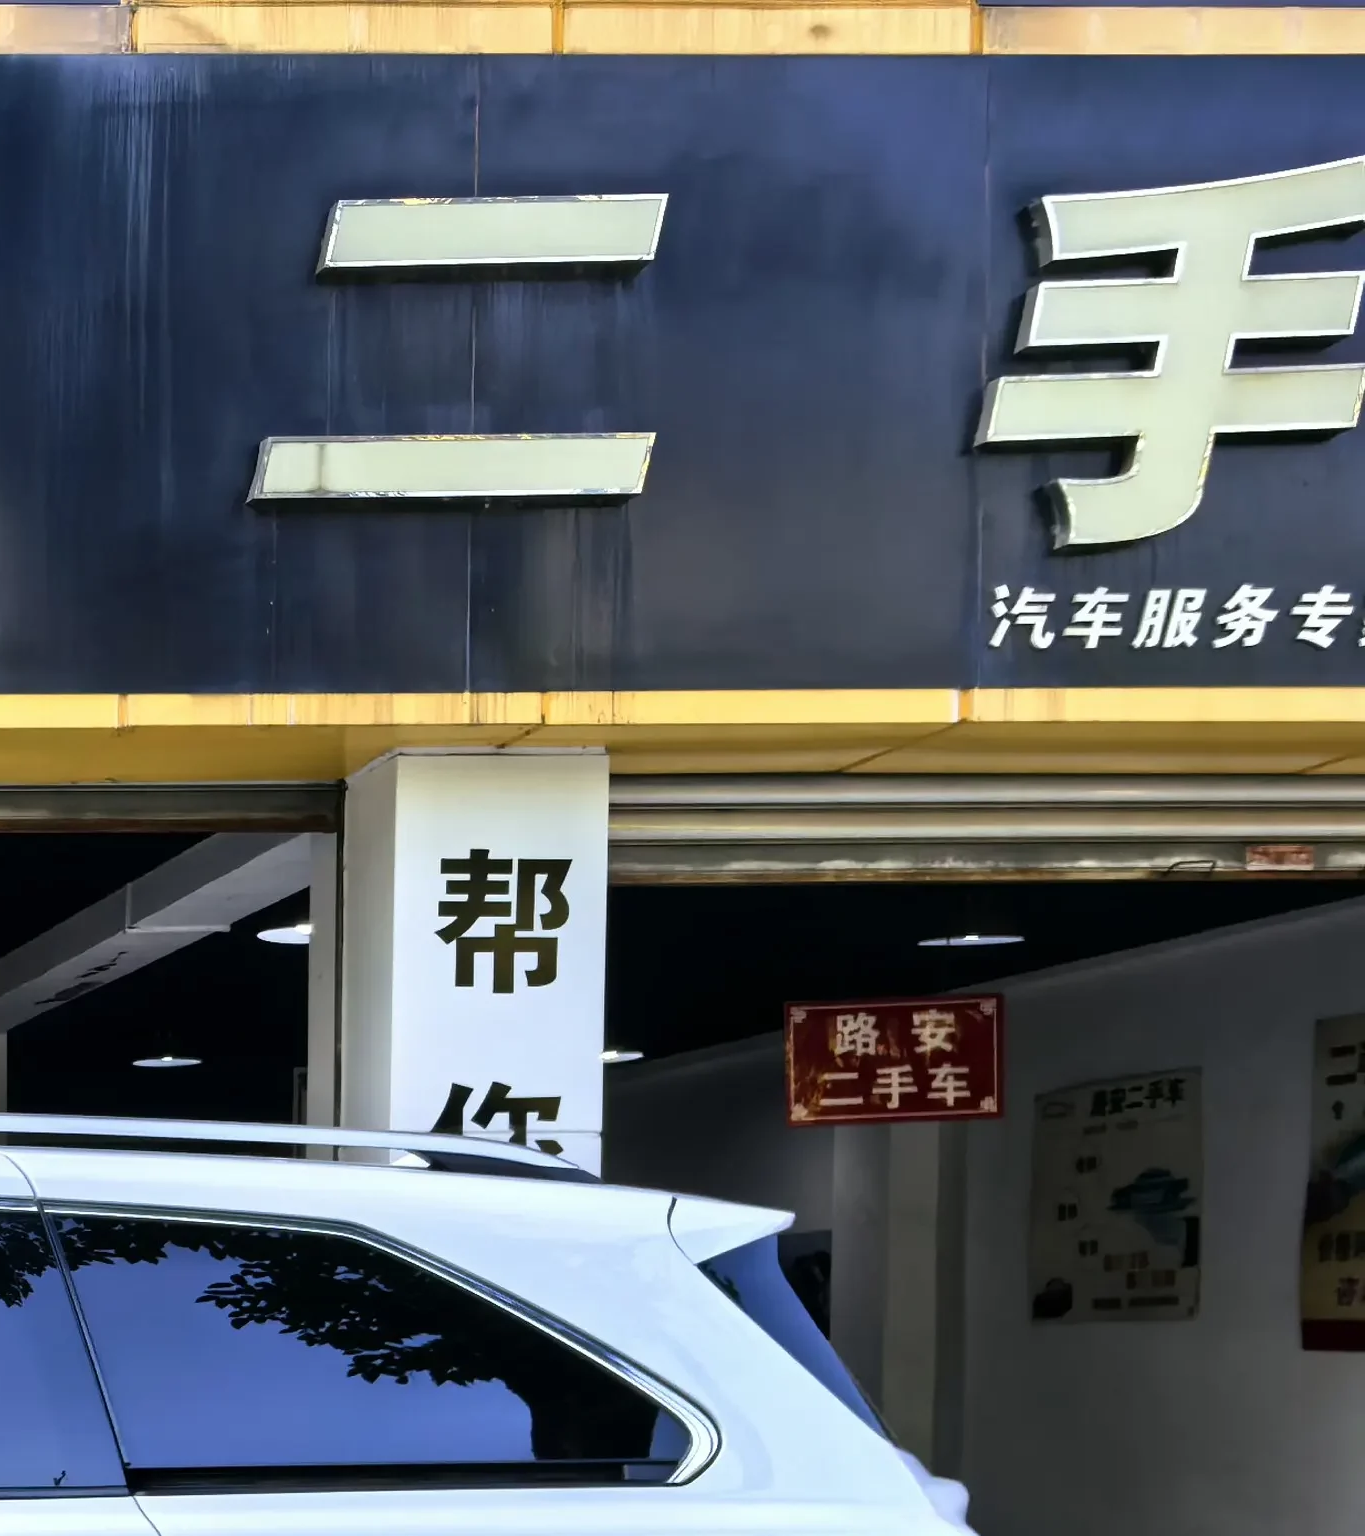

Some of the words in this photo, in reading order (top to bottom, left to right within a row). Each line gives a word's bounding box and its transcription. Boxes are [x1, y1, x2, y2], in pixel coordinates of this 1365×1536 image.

[987, 583, 1365, 650] 汽车服务专
[833, 1008, 956, 1057] 路安
[819, 1062, 971, 1110] 二手车
